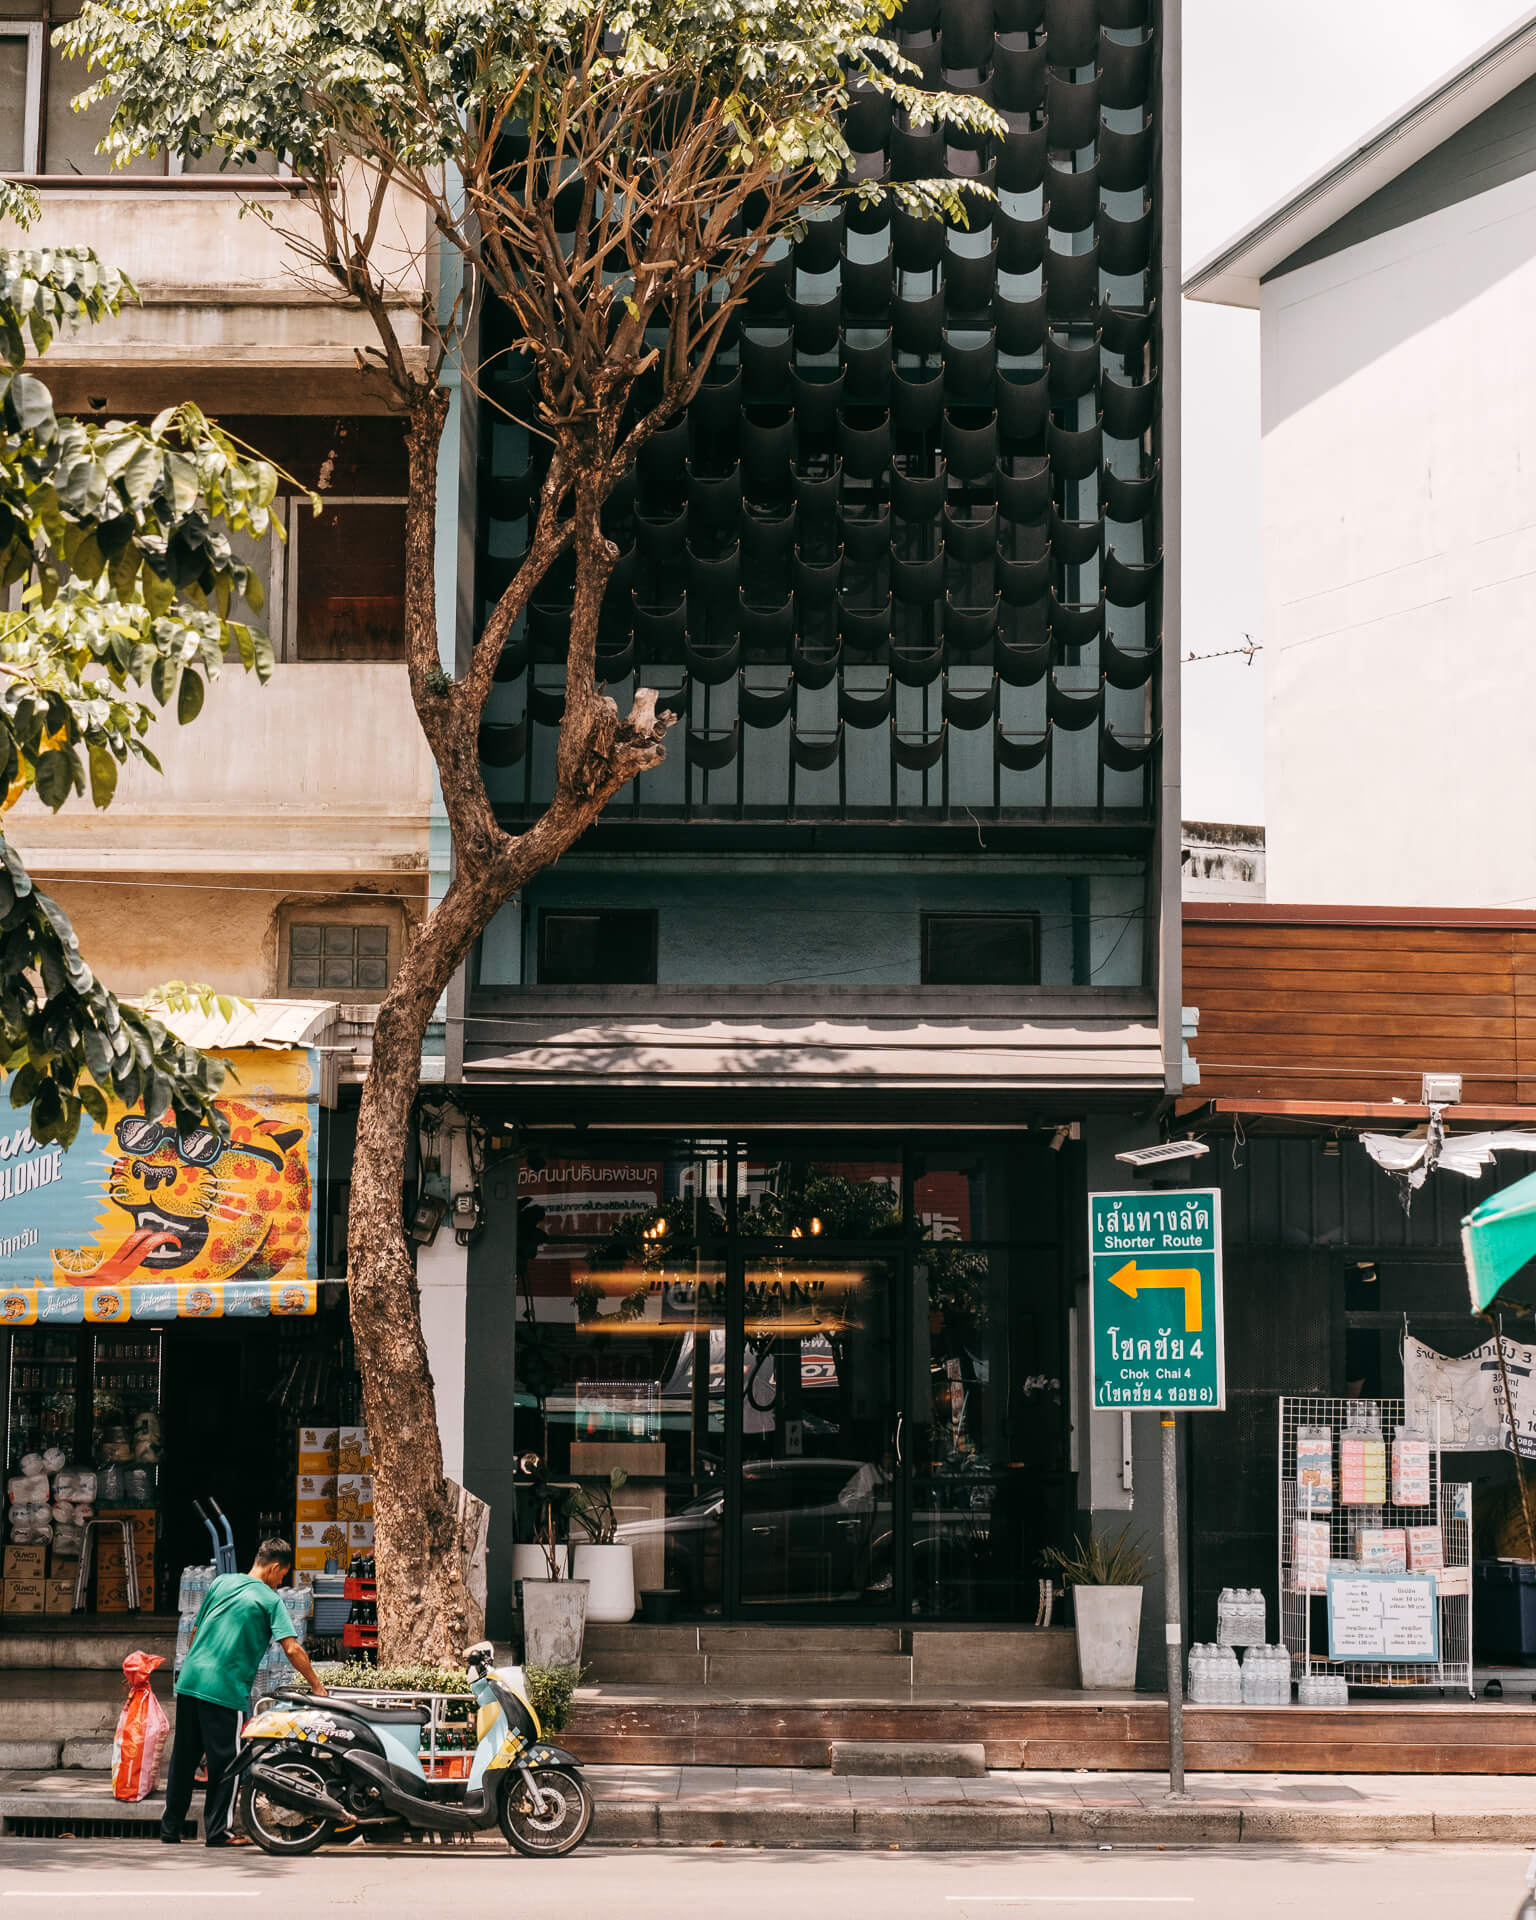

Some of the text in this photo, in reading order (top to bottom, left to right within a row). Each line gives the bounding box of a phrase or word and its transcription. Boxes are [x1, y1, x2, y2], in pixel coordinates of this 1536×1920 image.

[1097, 1201, 1209, 1233] เส้นทางลัด
[1104, 1235, 1203, 1248] Shorter Route
[1106, 1326, 1204, 1360] โชคชัย 4
[1416, 1346, 1435, 1360] ร้าน
[1521, 1351, 1533, 1363] 3
[1120, 1368, 1191, 1380] Chok Chai 4
[1154, 1388, 1163, 1401] 4
[1199, 1387, 1213, 1403] 8)
